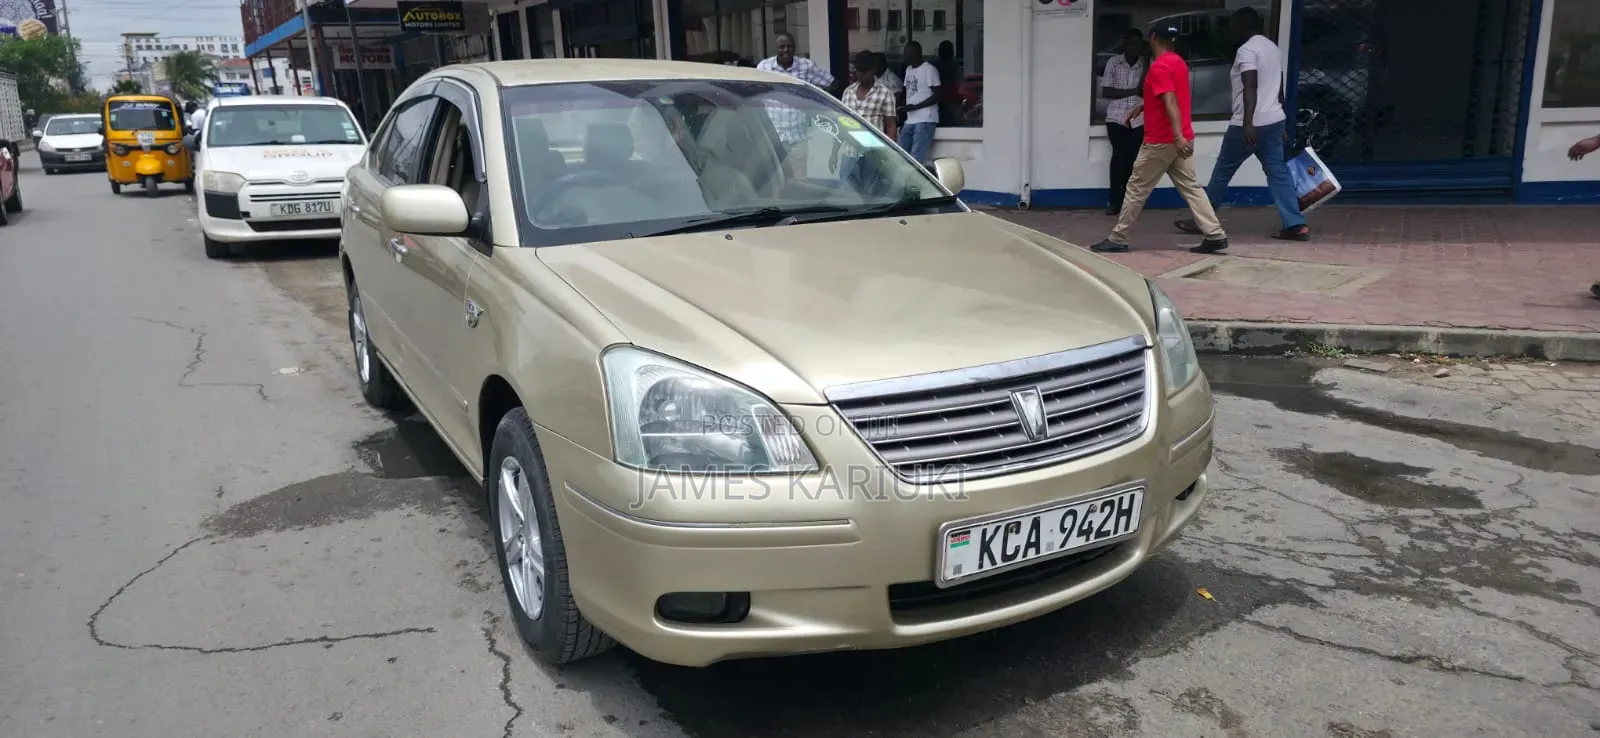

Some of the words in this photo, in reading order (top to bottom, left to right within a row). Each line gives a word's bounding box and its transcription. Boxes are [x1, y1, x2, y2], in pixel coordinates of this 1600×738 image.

[402, 11, 462, 21] AUTOBOX
[280, 203, 301, 216] KDG
[305, 201, 331, 213] 817U
[978, 516, 1041, 570] KCA
[1059, 493, 1136, 549] 942H
